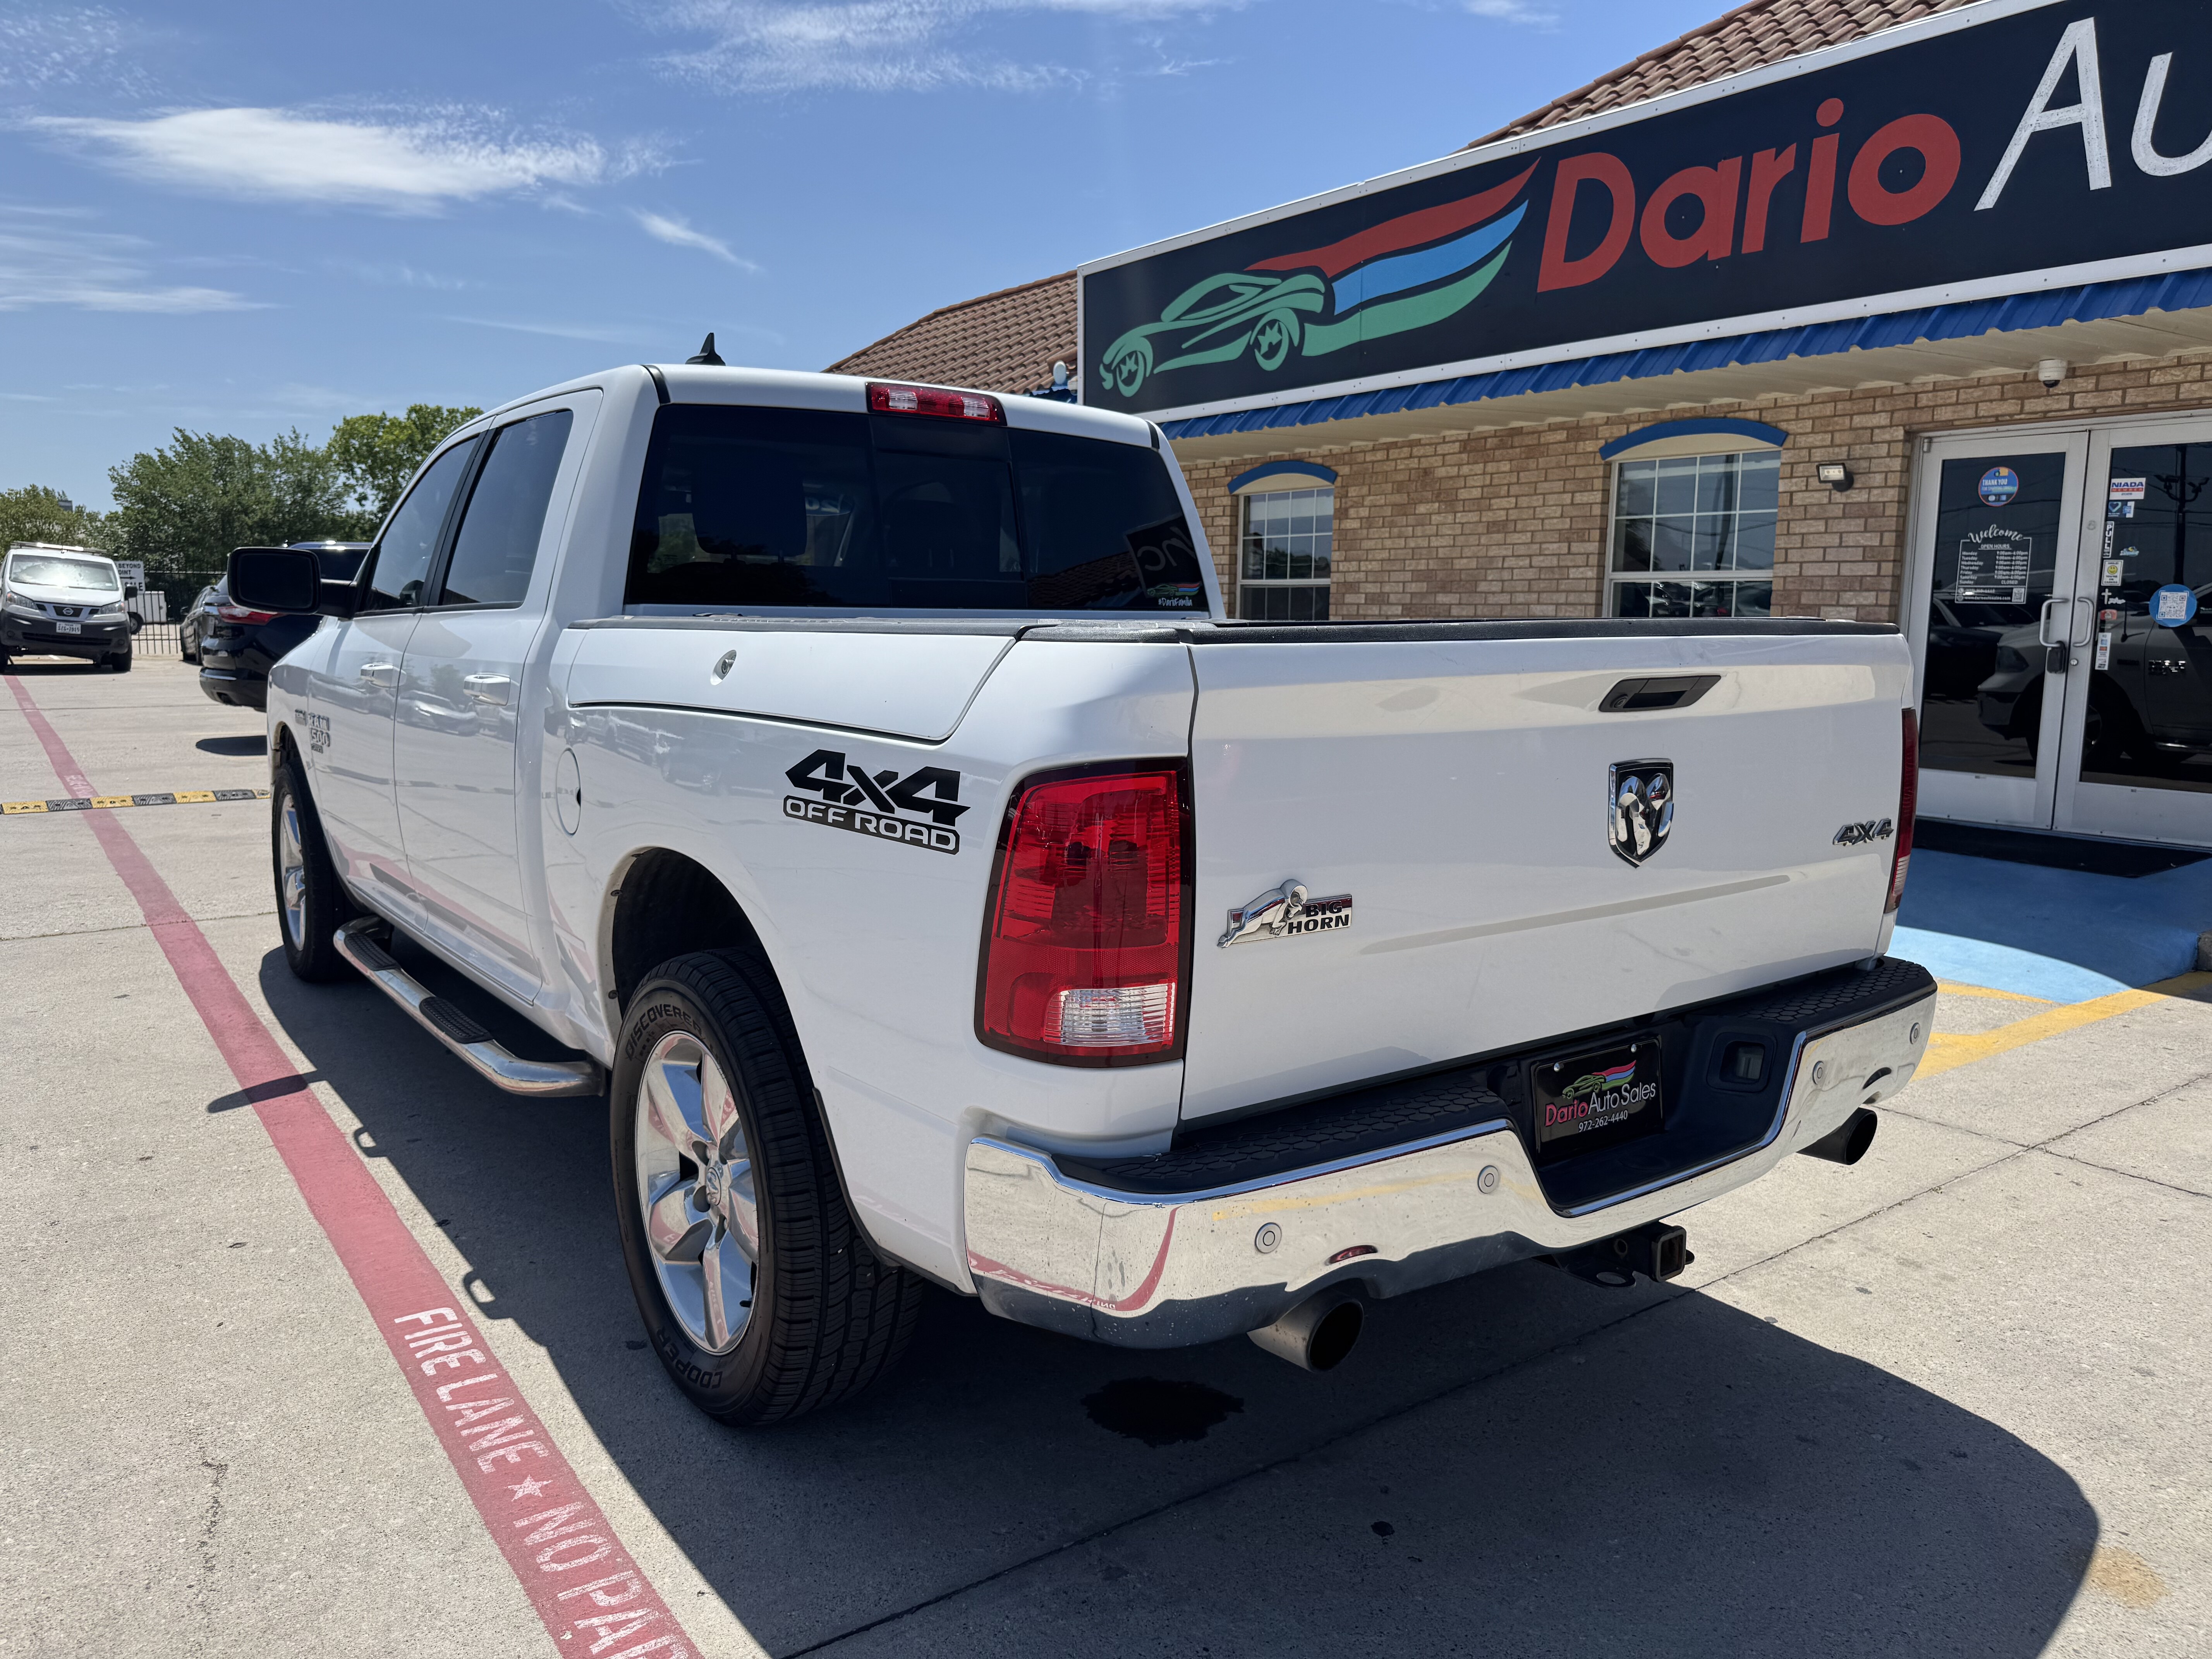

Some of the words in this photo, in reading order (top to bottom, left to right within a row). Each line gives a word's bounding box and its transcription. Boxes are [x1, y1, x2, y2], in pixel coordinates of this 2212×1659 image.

[1537, 97, 1961, 293] Dario
[1968, 524, 2023, 543] Welcome
[786, 798, 848, 823] OFF
[855, 812, 956, 850] ROAD
[1288, 914, 1349, 934] HORN
[1305, 900, 1342, 918] BIG
[1545, 1099, 1588, 1127] Dario
[1588, 1091, 1620, 1115] Auto
[1621, 1082, 1656, 1106] Sales
[1578, 1109, 1628, 1132] 972-262-4440
[394, 1307, 487, 1377] FIRE
[656, 1326, 723, 1389] COOPER
[436, 1373, 549, 1474] LANE
[513, 1501, 612, 1572] NO
